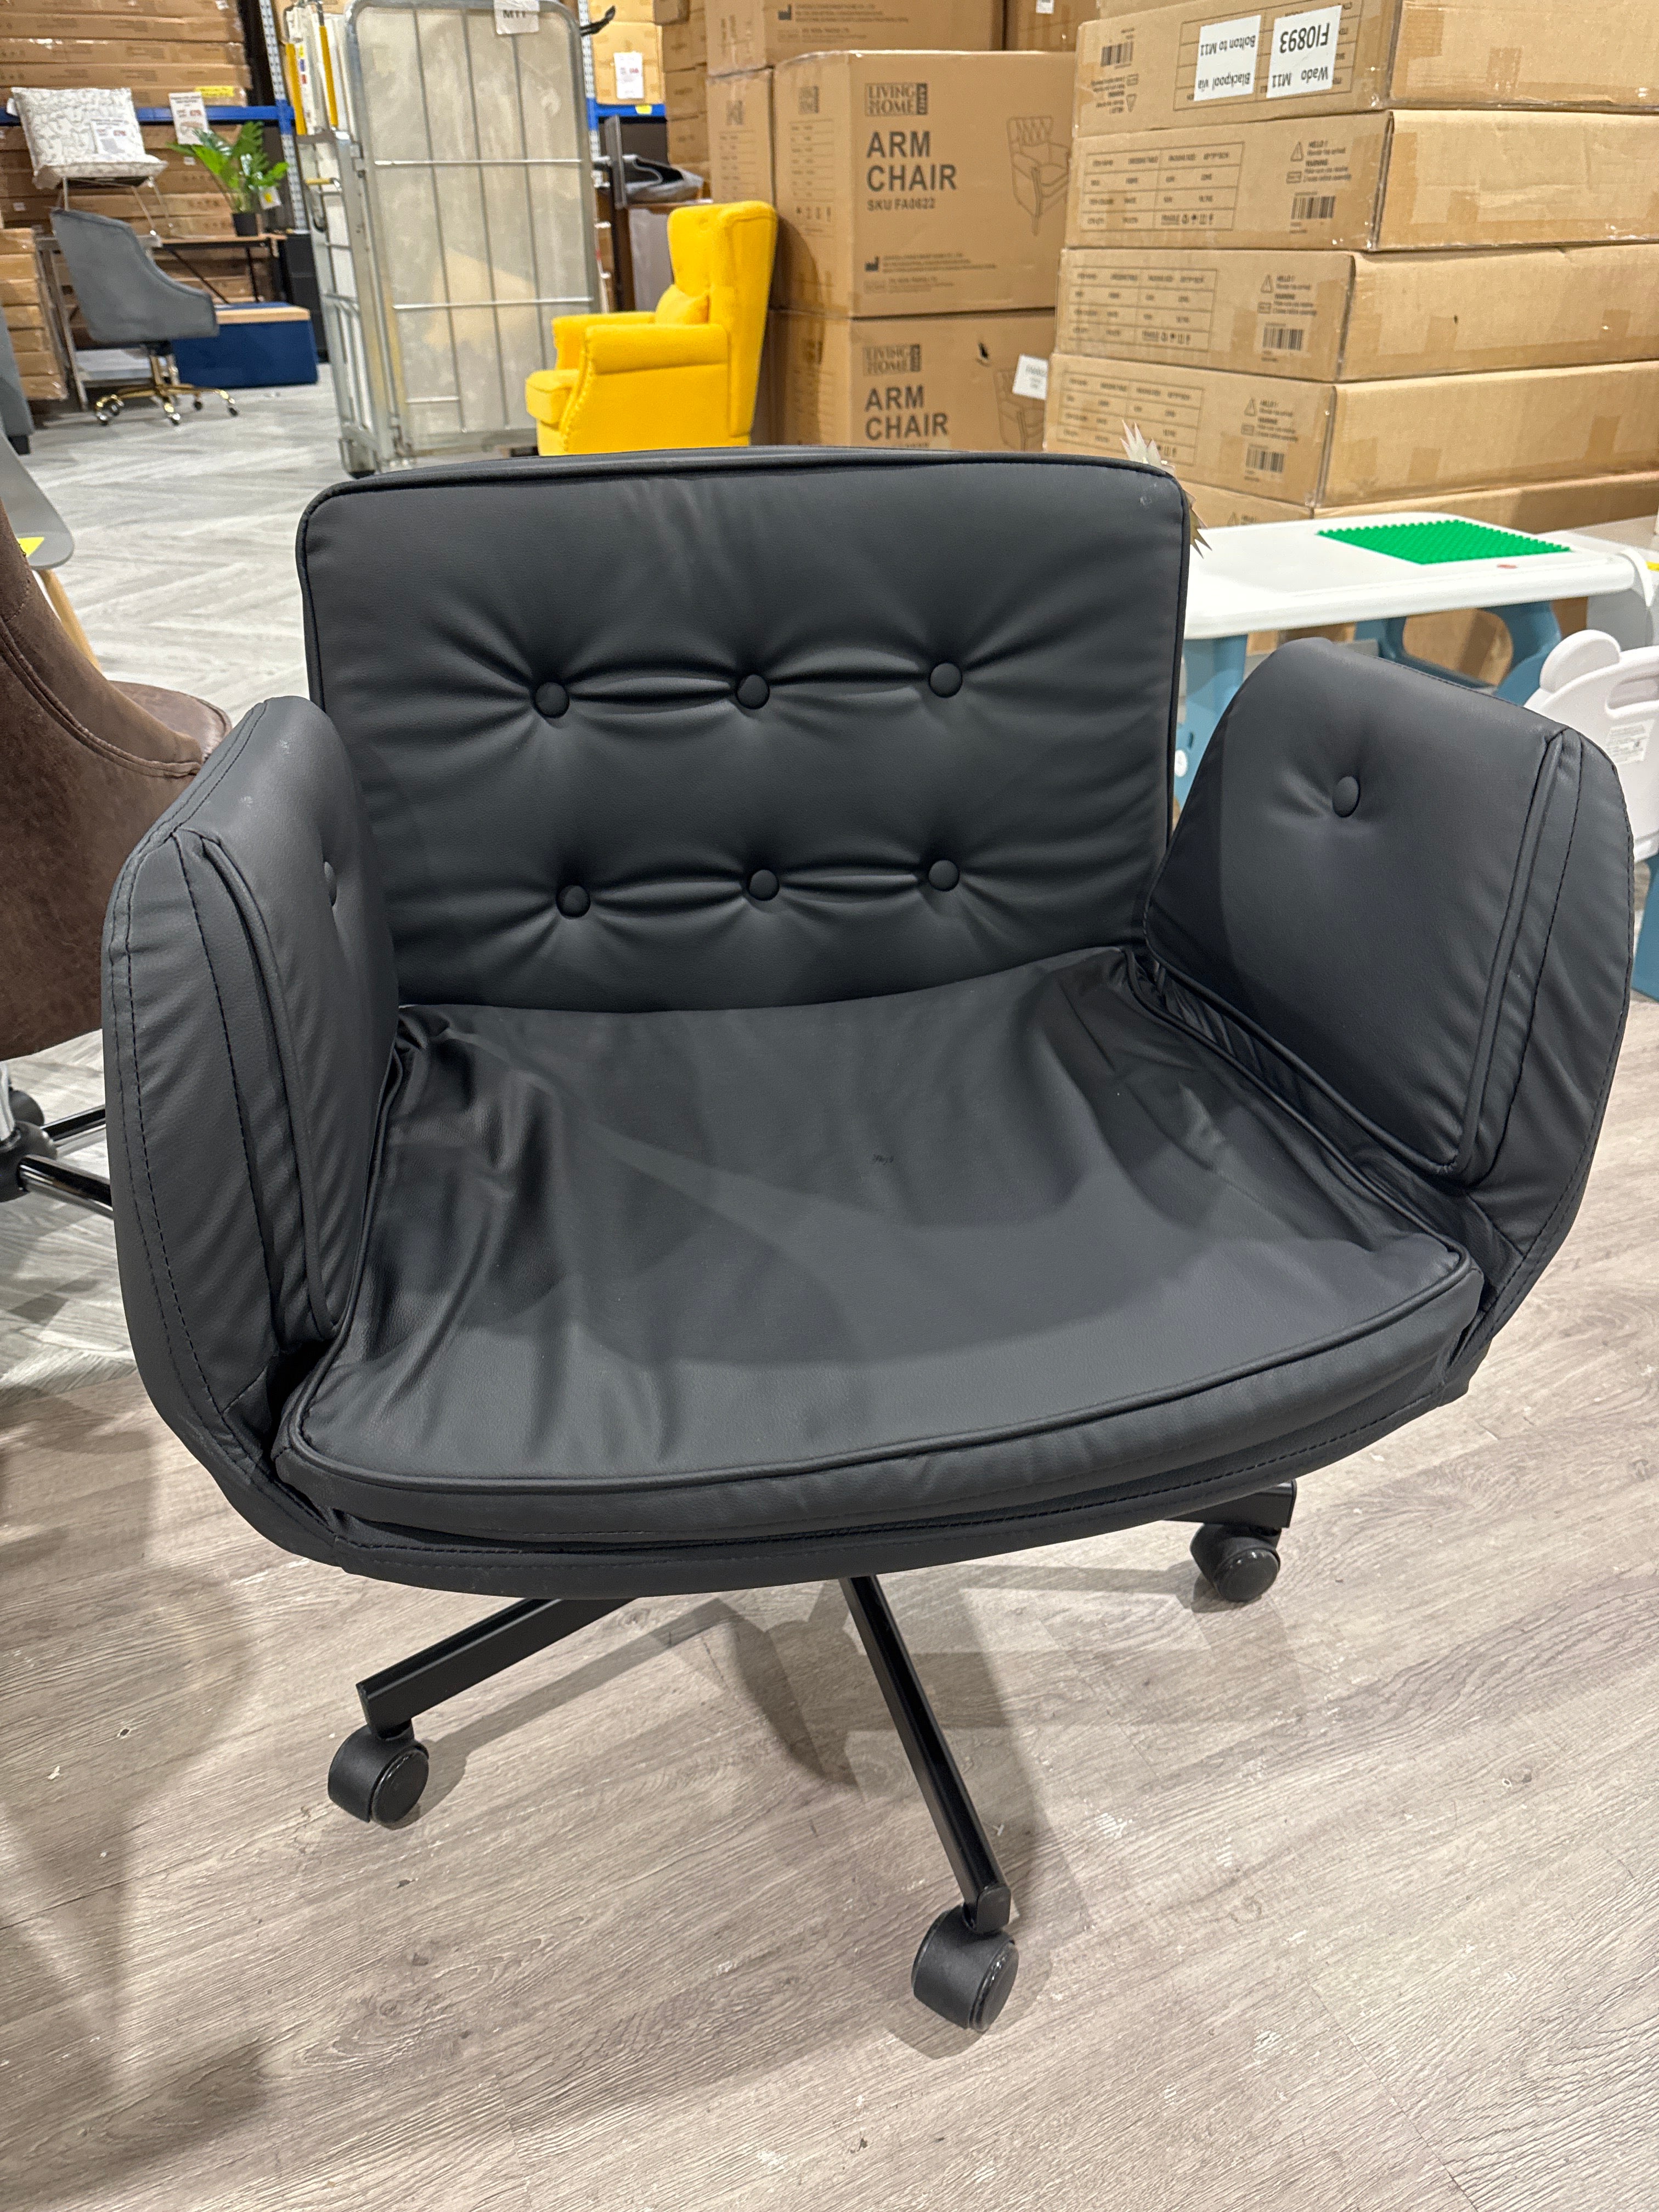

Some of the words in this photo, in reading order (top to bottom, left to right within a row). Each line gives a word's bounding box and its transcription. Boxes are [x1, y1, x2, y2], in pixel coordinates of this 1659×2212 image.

[1219, 40, 1227, 51] to
[1229, 35, 1255, 50] Bolton
[1279, 22, 1330, 53] FI0893
[1200, 42, 1217, 56] M11
[1211, 72, 1250, 91] Blackpool
[1272, 72, 1291, 88] M11
[1301, 66, 1328, 83] Wado
[868, 86, 915, 99] LIVING
[1198, 79, 1208, 92] via
[868, 100, 915, 114] HOME
[866, 131, 930, 158] ARM
[866, 164, 957, 192] CHAIR
[867, 199, 892, 211] SKU
[865, 385, 924, 412] ARM
[865, 413, 948, 441] CHAIR
